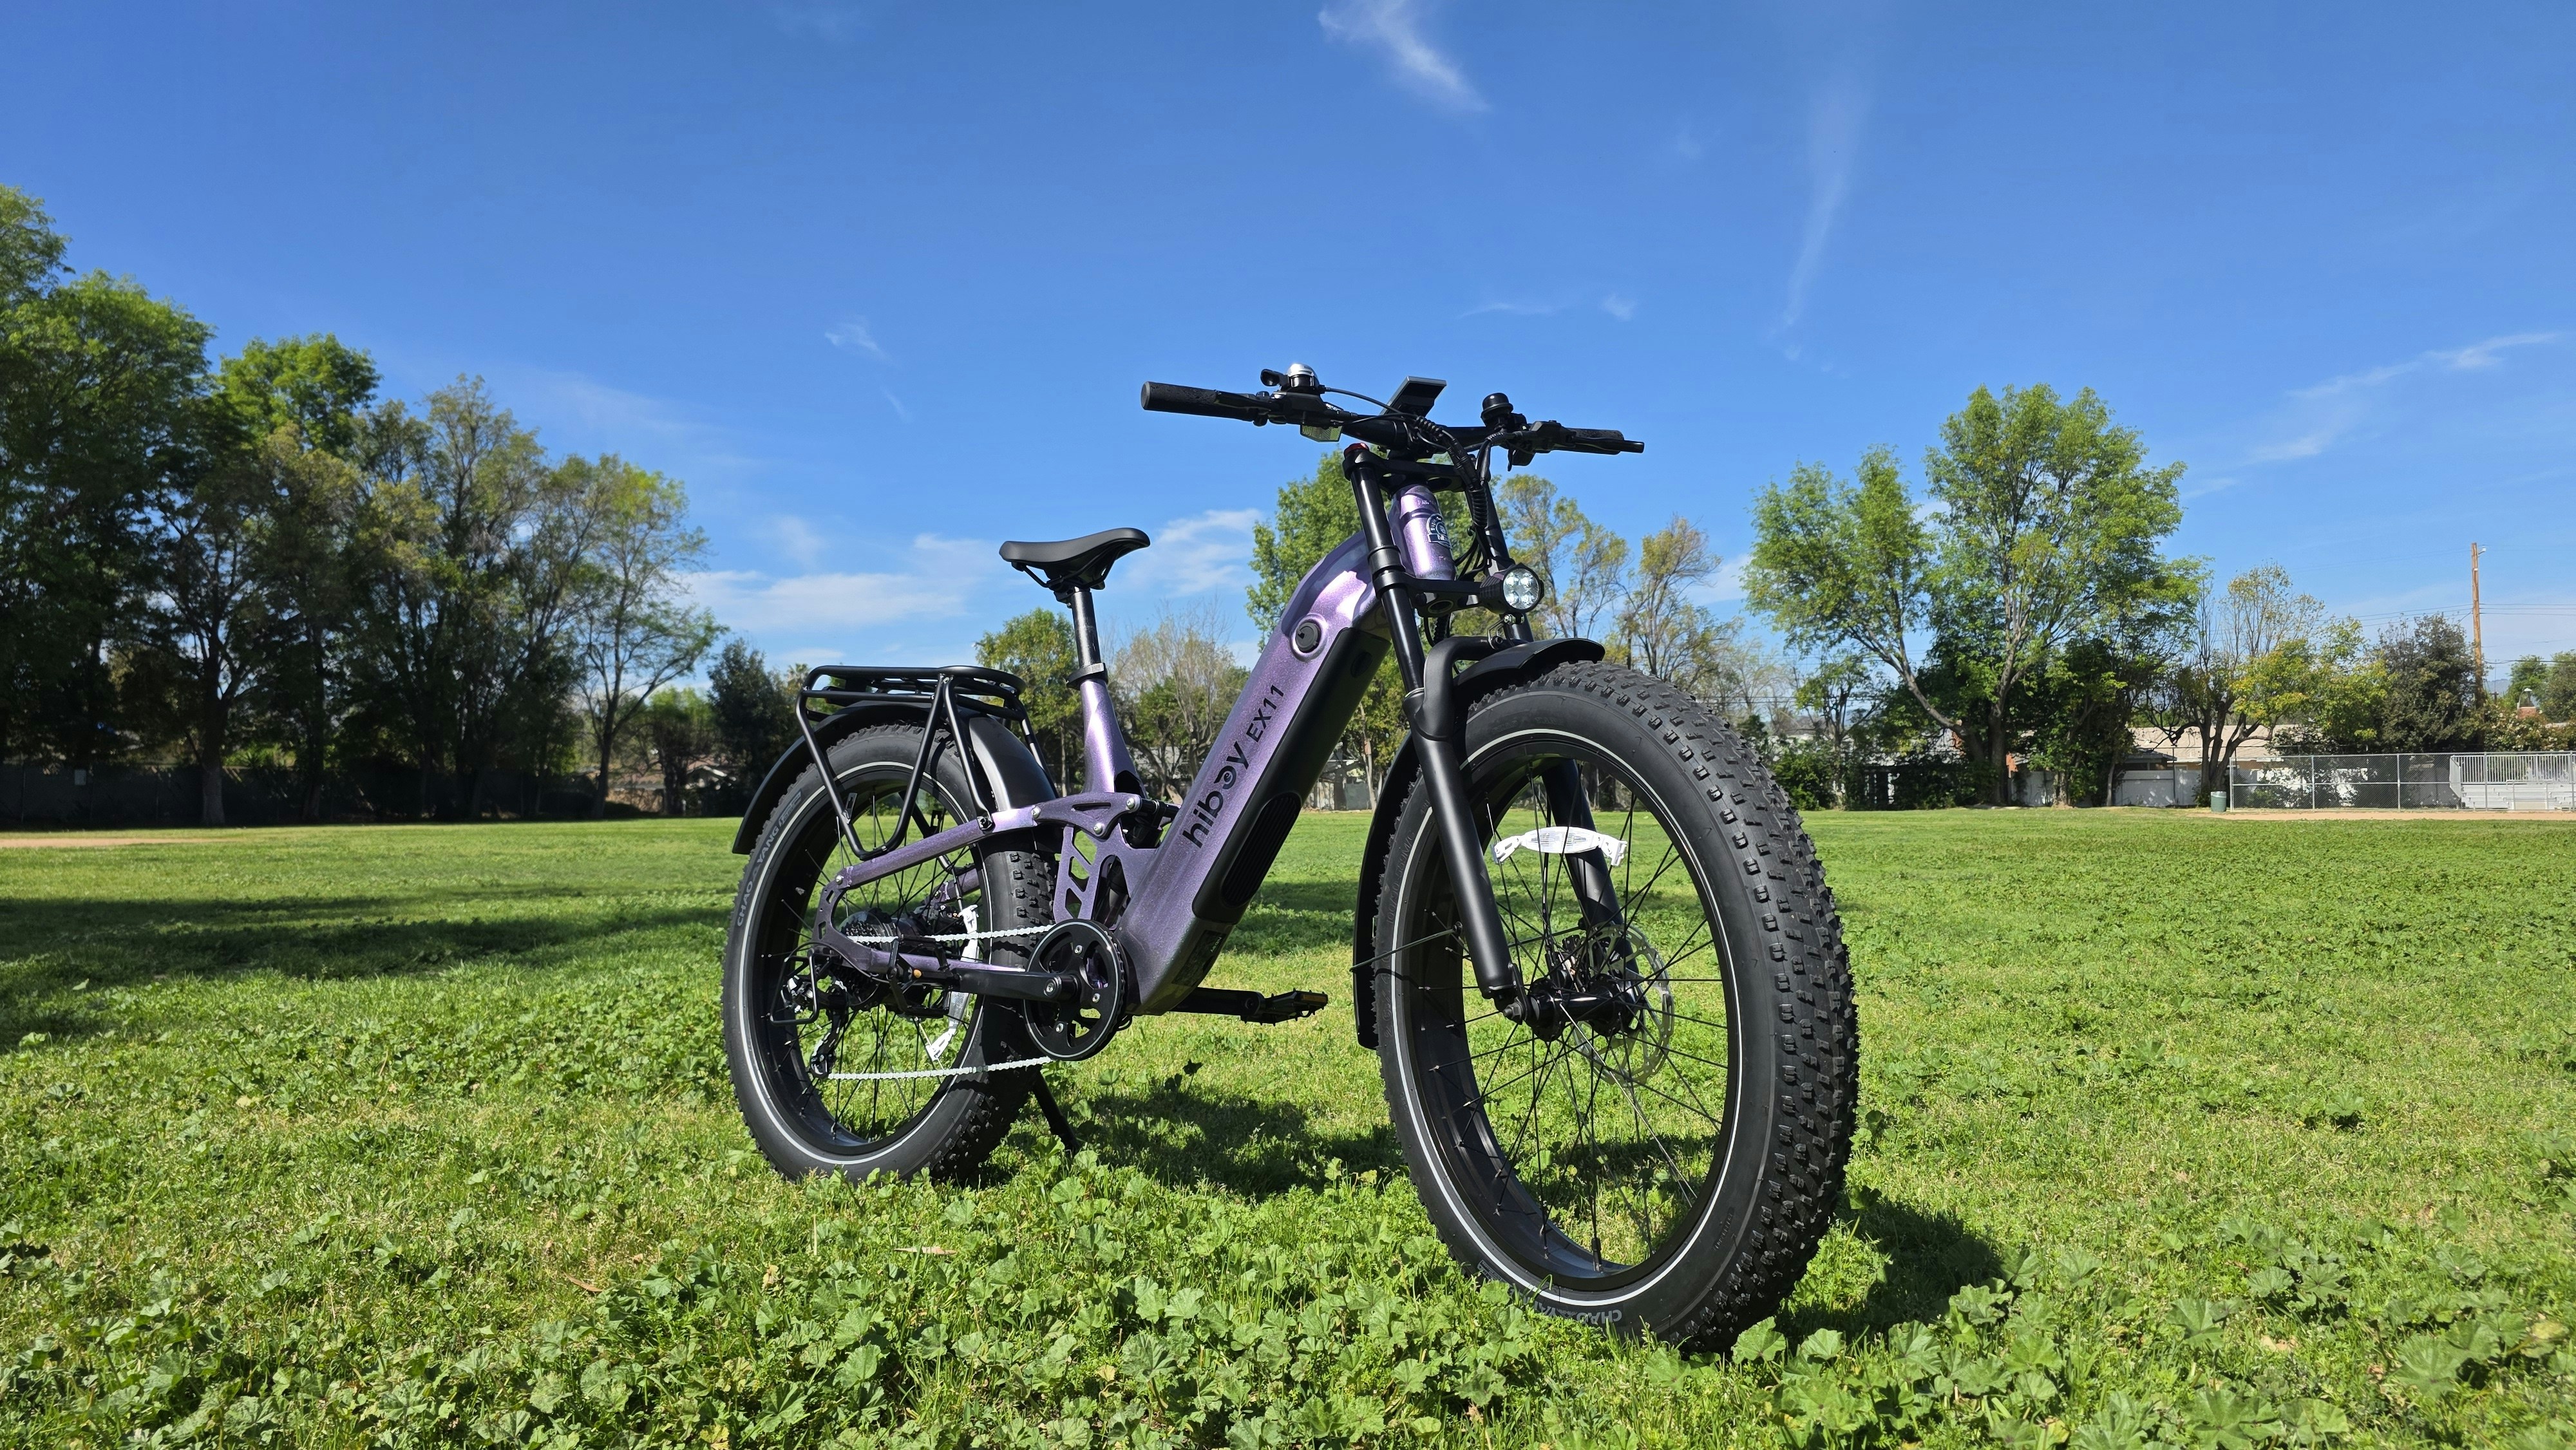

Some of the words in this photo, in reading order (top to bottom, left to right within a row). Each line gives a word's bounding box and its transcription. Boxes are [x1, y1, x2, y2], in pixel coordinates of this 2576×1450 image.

[1182, 740, 1249, 849] hiboy
[1245, 684, 1284, 742] EX11
[737, 881, 753, 926] CHAO
[757, 825, 779, 863] YANG
